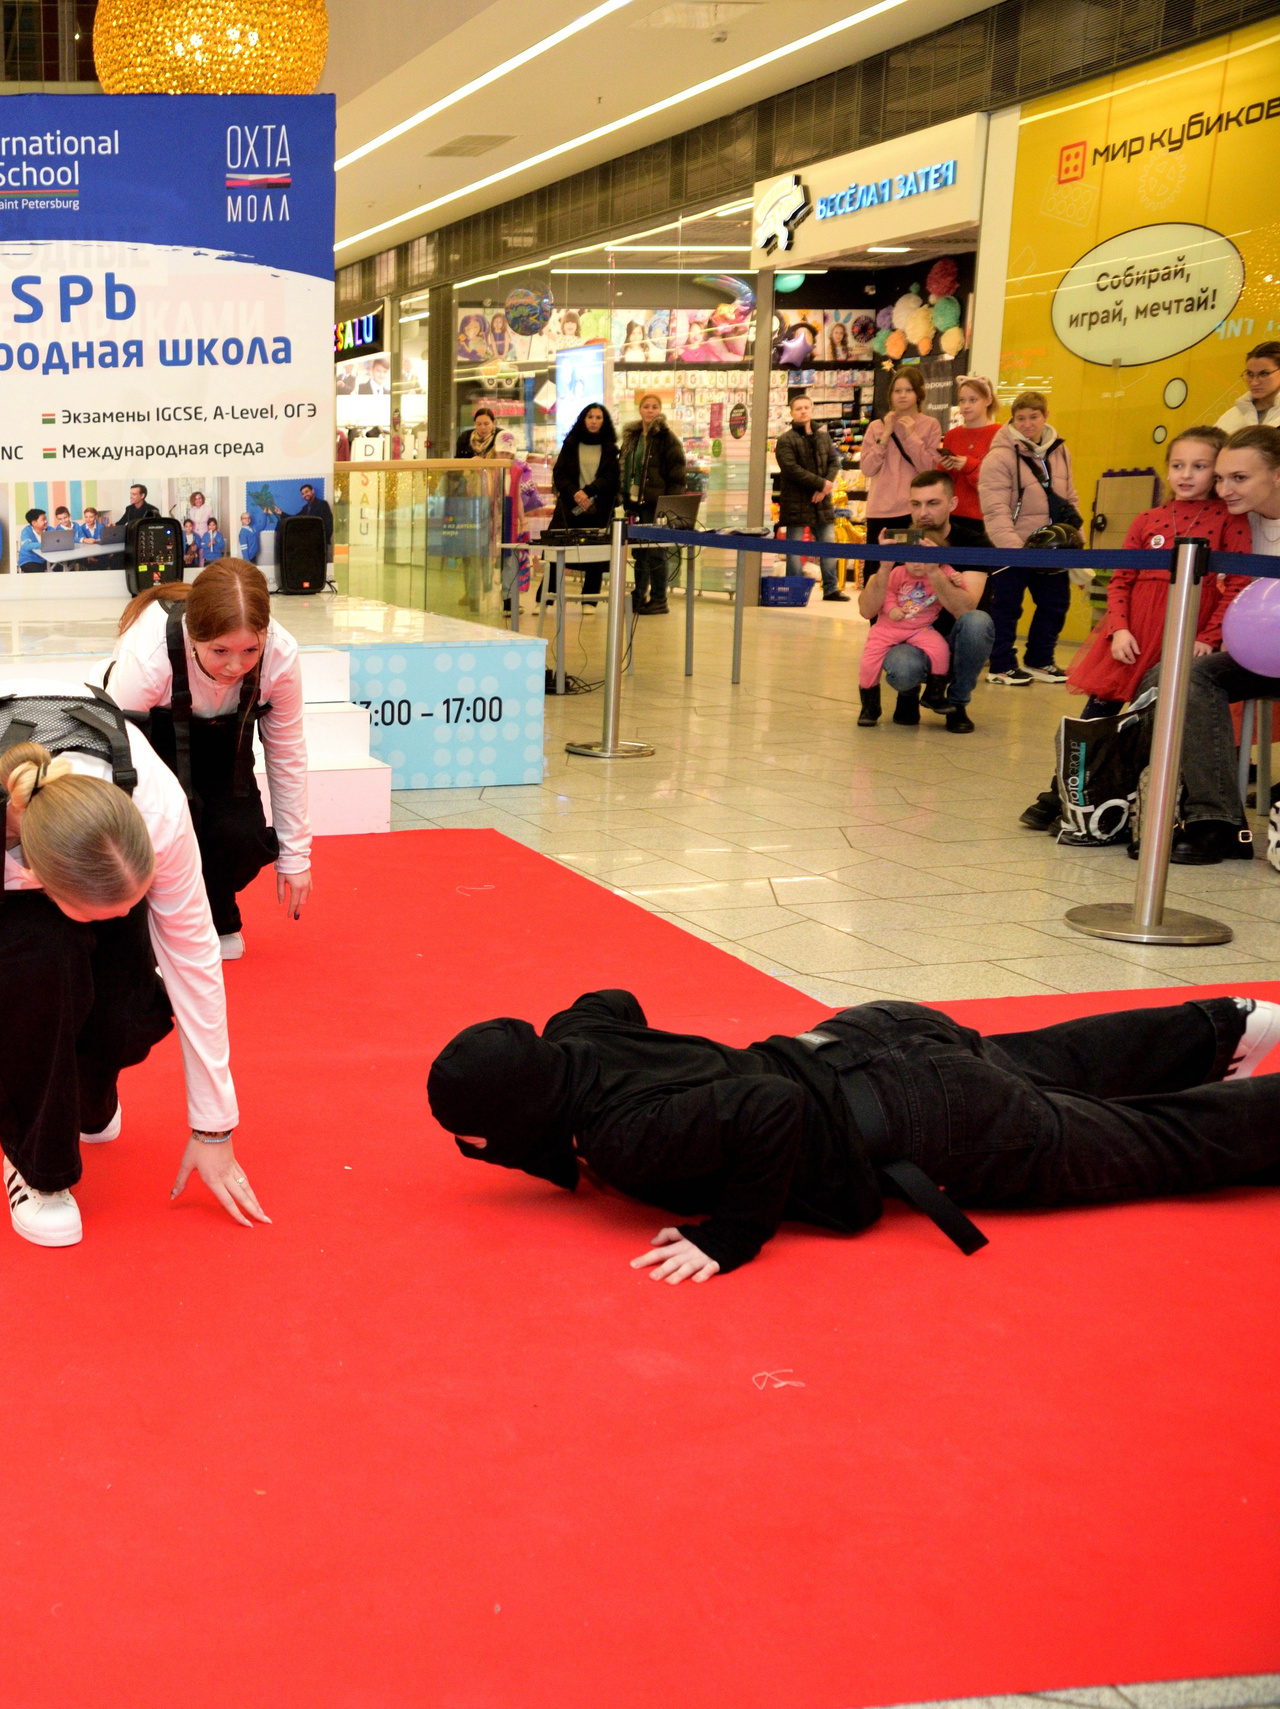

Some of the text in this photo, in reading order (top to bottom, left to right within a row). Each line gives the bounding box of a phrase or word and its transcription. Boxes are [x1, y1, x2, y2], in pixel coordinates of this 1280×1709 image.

[226, 124, 292, 169] ОХТА
[1092, 96, 1280, 166] мир кубиков
[21, 198, 80, 211] Petersburg
[816, 160, 957, 220] ВЕСЁЛАЯ ЗАТЕЯ
[226, 194, 291, 223] МОЛЛ
[1096, 255, 1191, 293] Собирай,
[1069, 286, 1217, 331] играй, мечтай!
[159, 336, 292, 367] школа
[61, 403, 317, 425] Экзамены IGCSE, A-Level, ОГЭ
[62, 442, 264, 461] Международная среда
[353, 699, 412, 727] :00
[442, 695, 503, 724] 17:00
